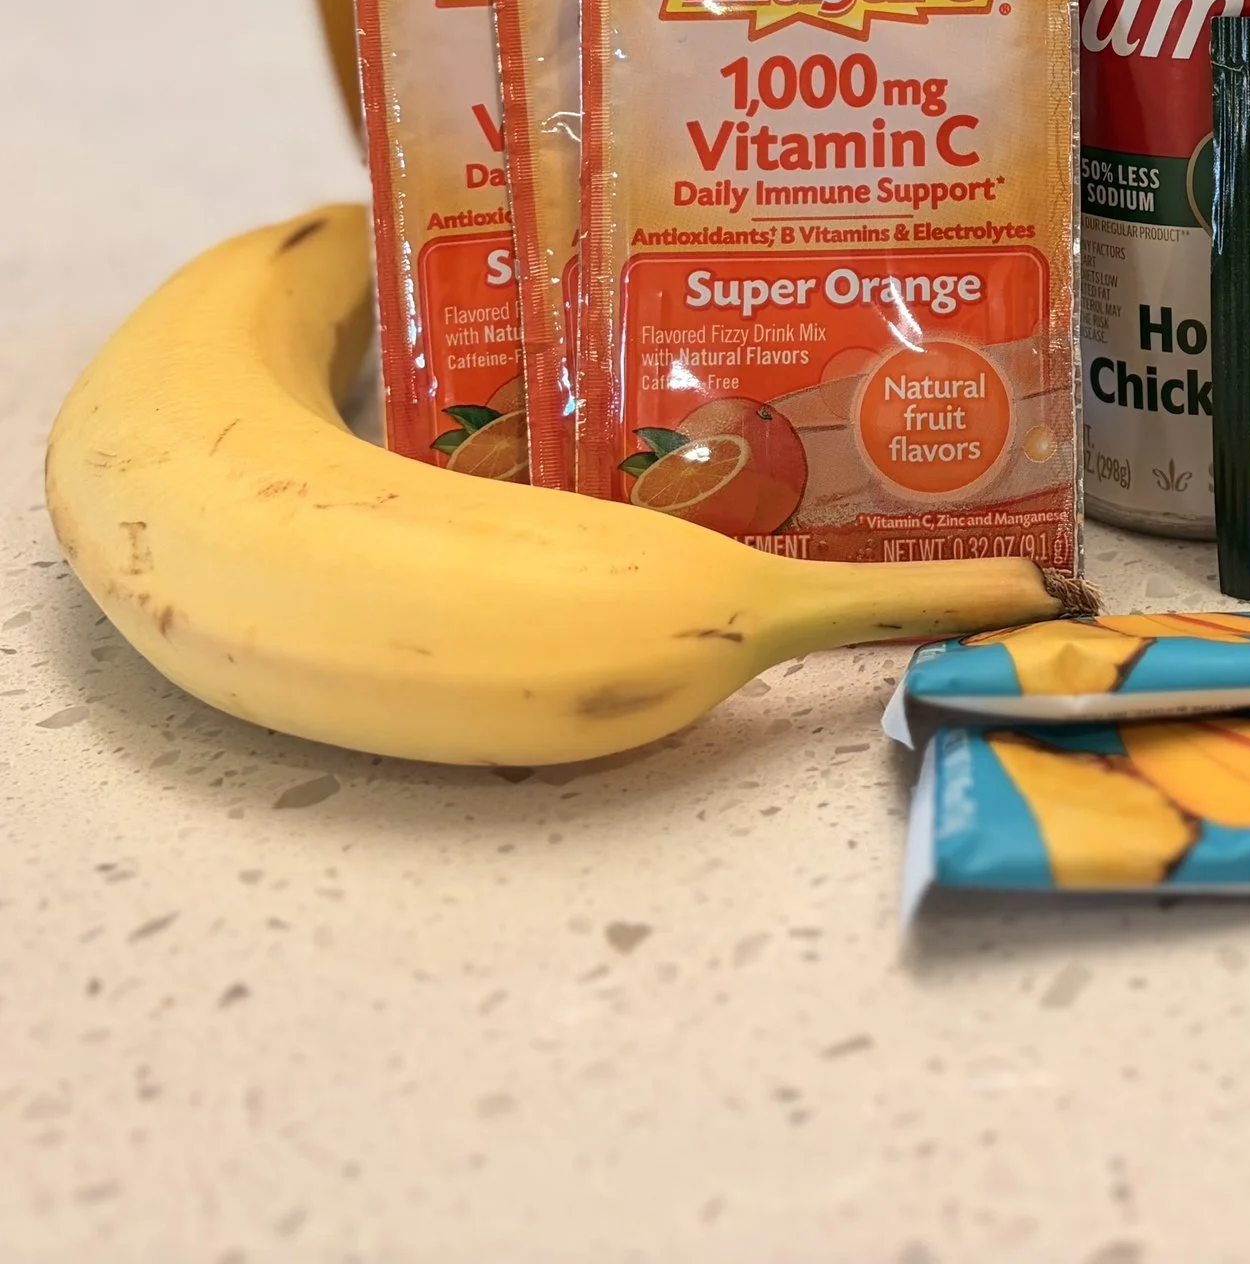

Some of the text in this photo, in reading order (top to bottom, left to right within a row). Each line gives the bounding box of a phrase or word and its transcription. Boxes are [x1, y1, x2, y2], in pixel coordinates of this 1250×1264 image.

[720, 53, 948, 117] 1,000 mg
[686, 114, 980, 171] Vitamin C
[1082, 158, 1160, 189] 50% LESS
[674, 180, 749, 213] Daily
[756, 181, 870, 206] Immune
[1087, 183, 1154, 212] SODIUM
[781, 227, 794, 243] B
[799, 224, 890, 243] Vitamins
[893, 223, 911, 241] &
[913, 221, 1036, 244] Electrolytes
[1102, 221, 1138, 238] REGULAR
[1092, 243, 1126, 260] FACTORS
[686, 268, 982, 316] Super Orange
[444, 302, 510, 325] Flavored
[1105, 302, 1121, 318] MAY
[446, 330, 479, 347] with
[641, 323, 826, 346] Flavored Fizzy Drink Mix
[641, 347, 809, 366] with Natural Flavors
[884, 373, 985, 401] Natural
[1089, 356, 1214, 416] Chick
[904, 406, 966, 431] fruit
[889, 435, 980, 463] flavors
[1097, 451, 1131, 490] (298g)
[867, 515, 920, 529] Vitamin
[936, 514, 967, 527] Zinc
[967, 513, 992, 525] and
[995, 510, 1067, 529] Manganese
[883, 538, 919, 563] NET
